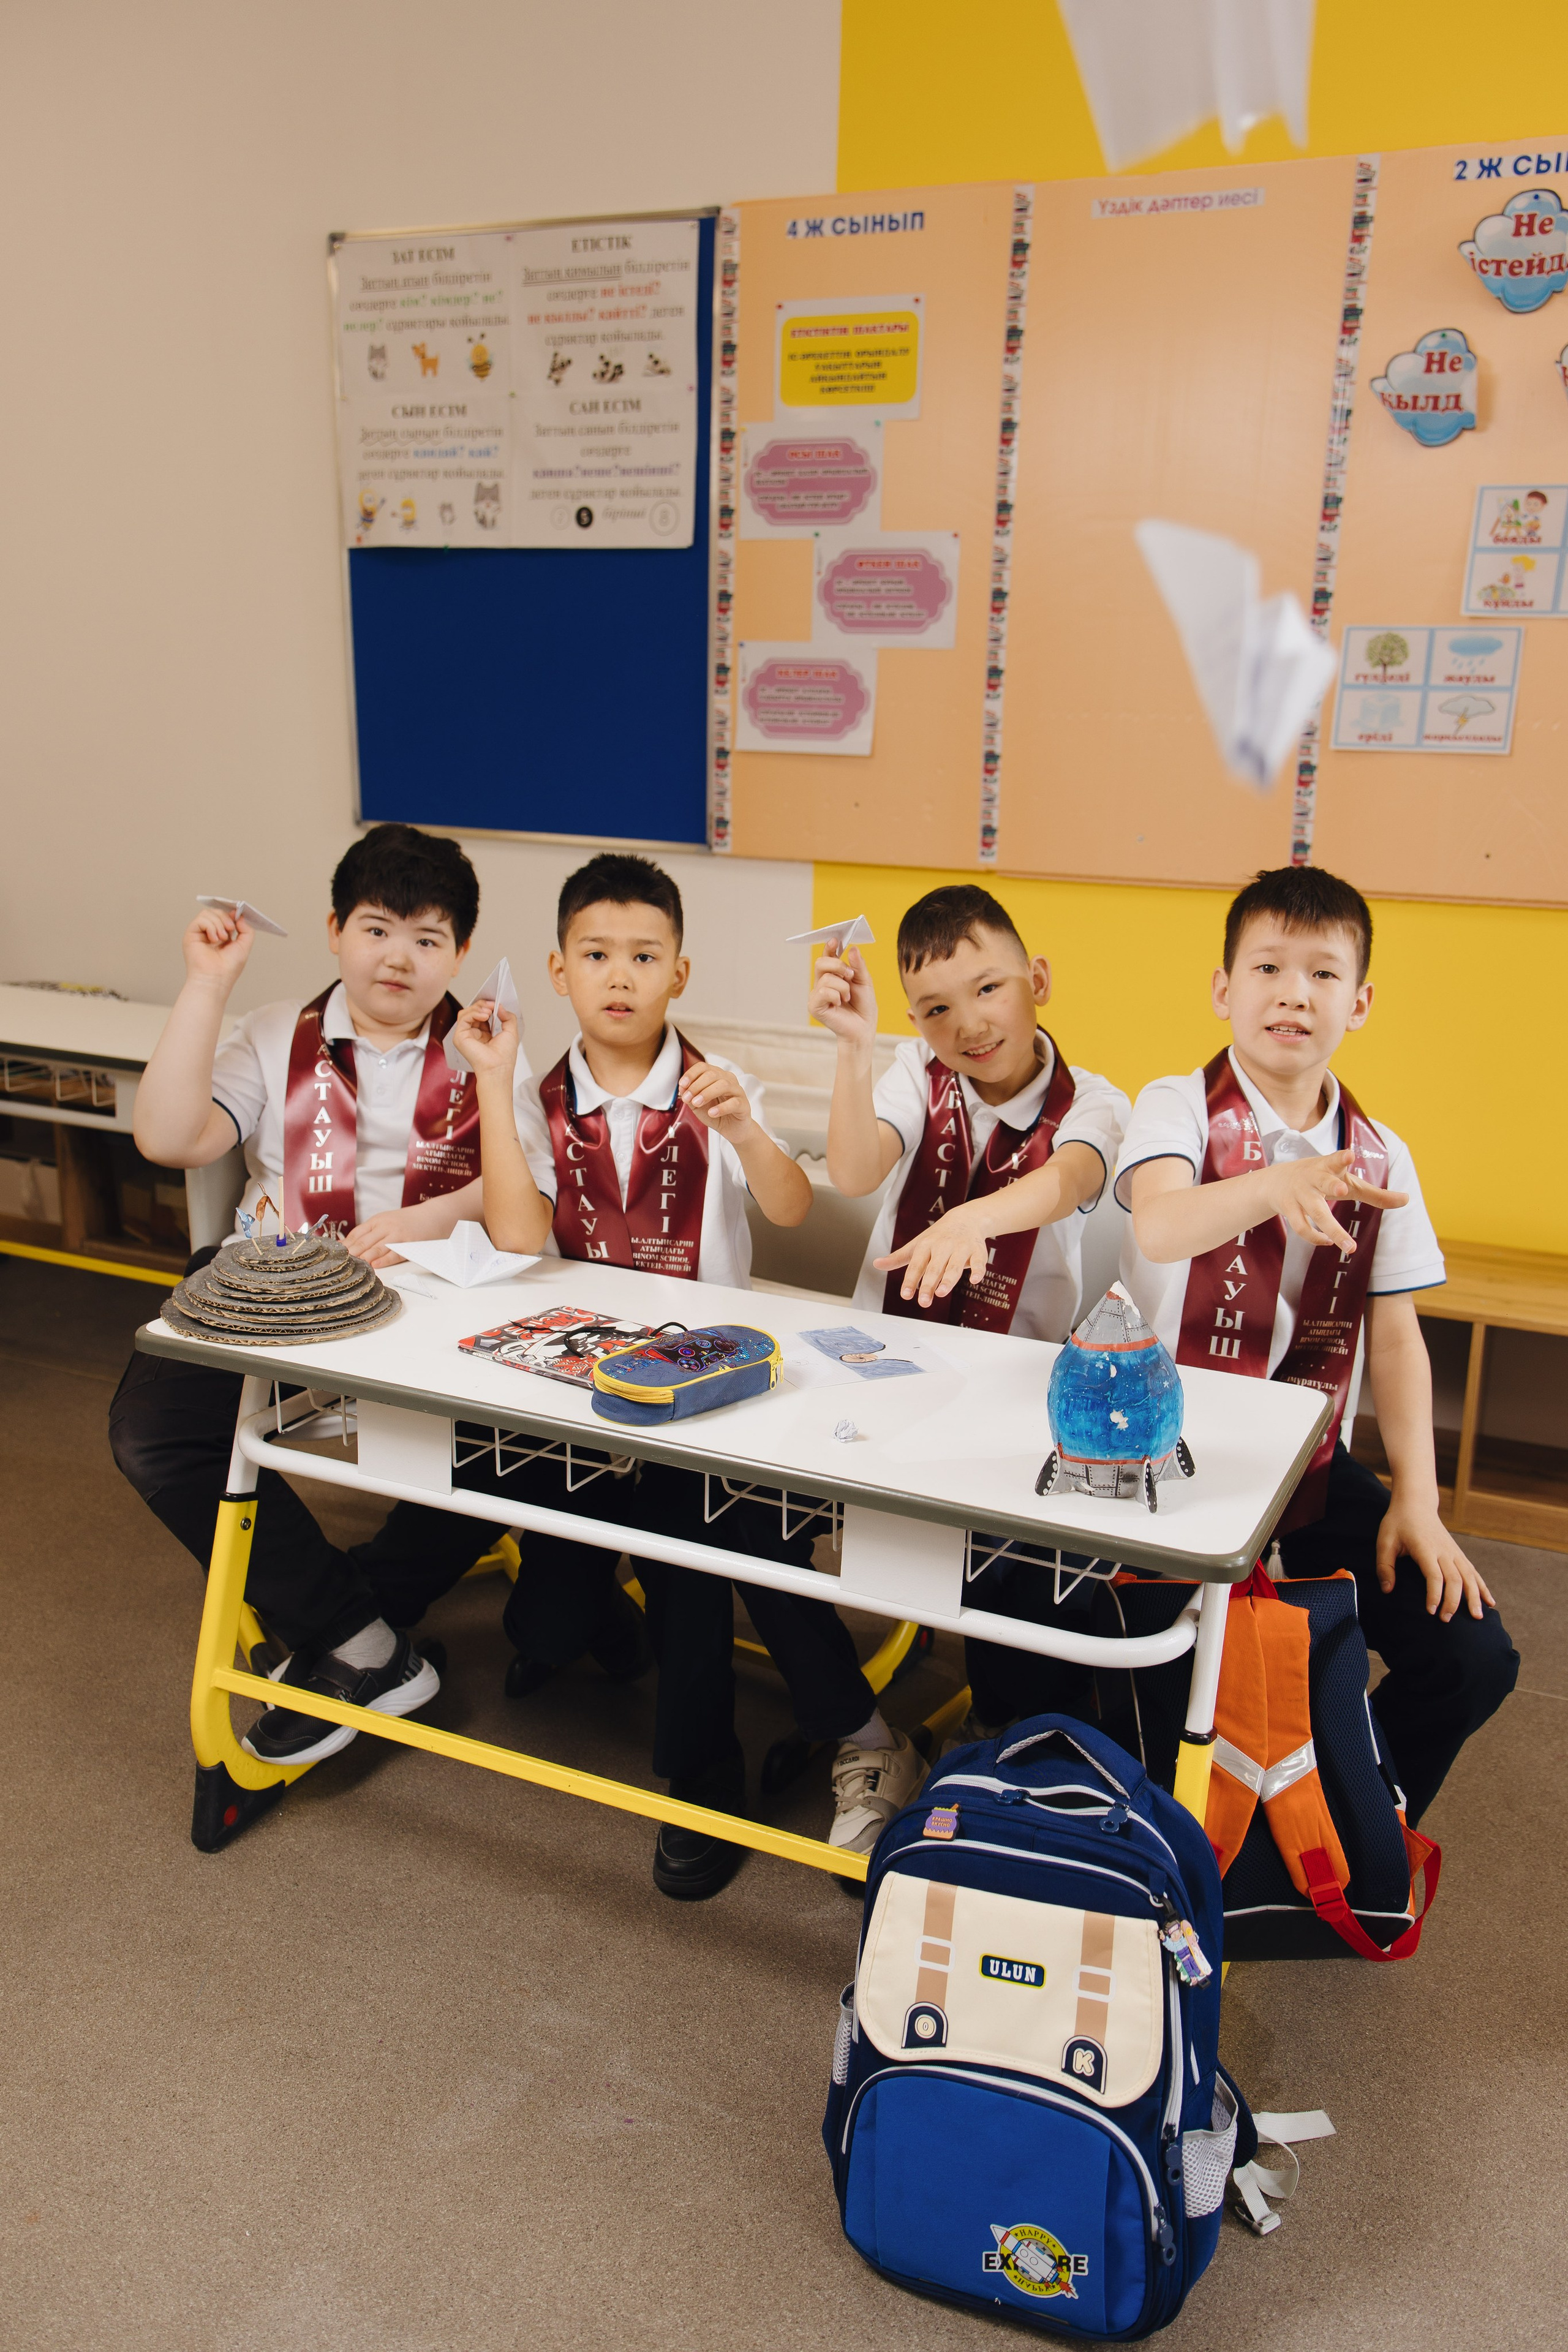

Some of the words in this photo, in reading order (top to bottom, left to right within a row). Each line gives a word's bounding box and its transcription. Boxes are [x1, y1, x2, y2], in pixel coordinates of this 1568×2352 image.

[1455, 160, 1468, 180] 2
[1477, 157, 1502, 178] Ж
[1513, 153, 1568, 175] СЫ
[1147, 195, 1214, 214] дәптер
[788, 221, 797, 237] 4
[805, 219, 824, 238] Ж
[832, 212, 924, 235] СЫНЫП
[1512, 214, 1553, 237] Не
[1469, 251, 1568, 277] істейд
[1423, 352, 1462, 374] Не
[446, 1069, 467, 1140] ЛЕГІ
[308, 1043, 334, 1194] АСТАУЫШ
[928, 1090, 962, 1215] БАСТА
[660, 1255, 690, 1264] SCHOOL
[1208, 1141, 1262, 1360] БТАУЫШ
[635, 1261, 692, 1272] ЕКТЕП-ЛИЦЕЙІ
[986, 1270, 1017, 1286] НСАРИН
[980, 1286, 1010, 1301] SCHOOL
[989, 1958, 1036, 1983] ULUN
[1072, 2048, 1095, 2076] K
[1019, 2228, 1052, 2244] HAPPY
[984, 2252, 1086, 2273] EXRE
